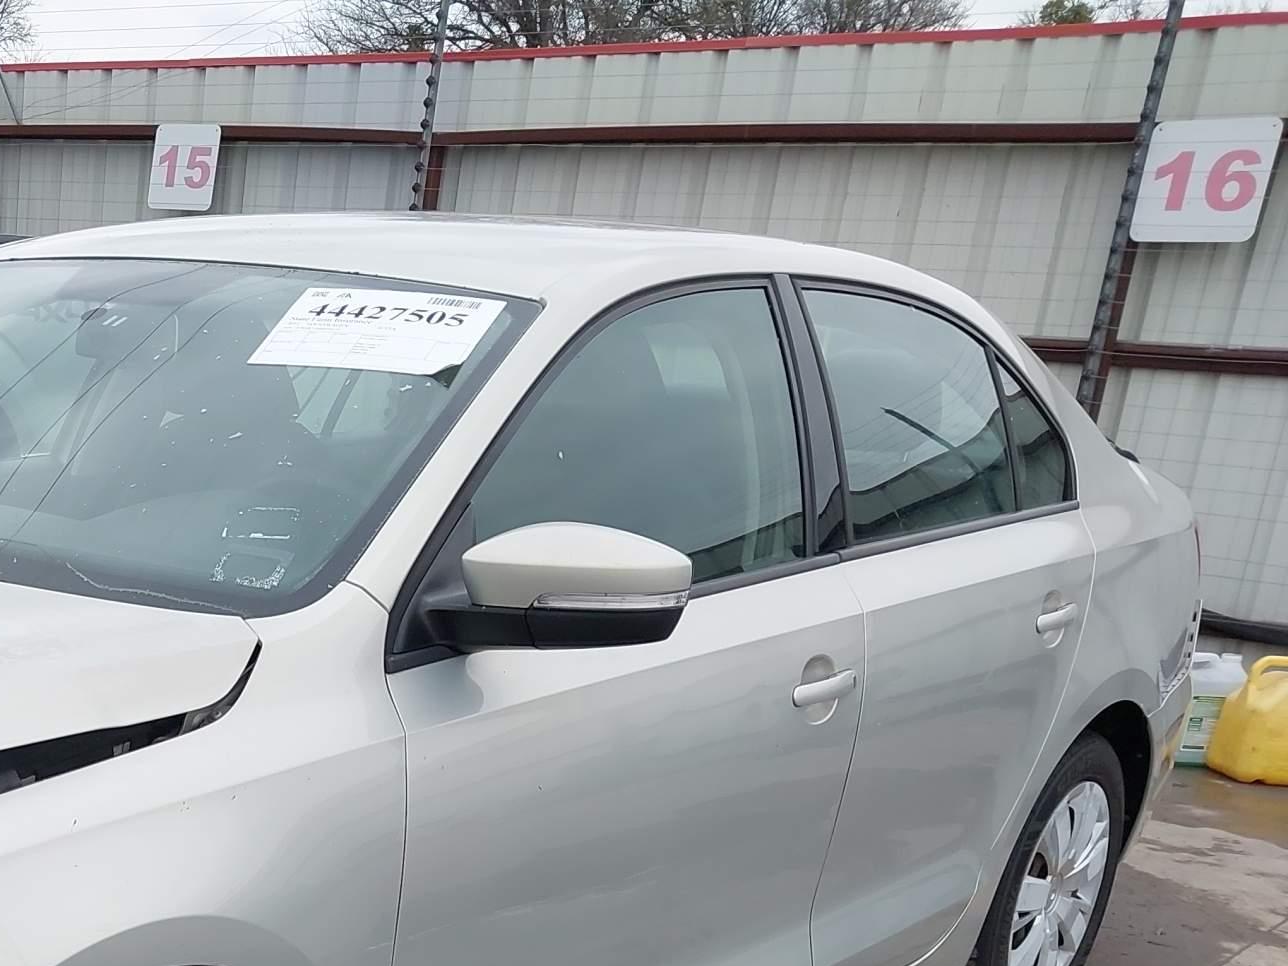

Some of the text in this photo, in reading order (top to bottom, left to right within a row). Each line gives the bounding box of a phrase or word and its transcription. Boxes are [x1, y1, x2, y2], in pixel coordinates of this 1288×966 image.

[158, 144, 213, 189] 15
[1153, 148, 1262, 212] 16
[308, 303, 470, 328] 44427505
